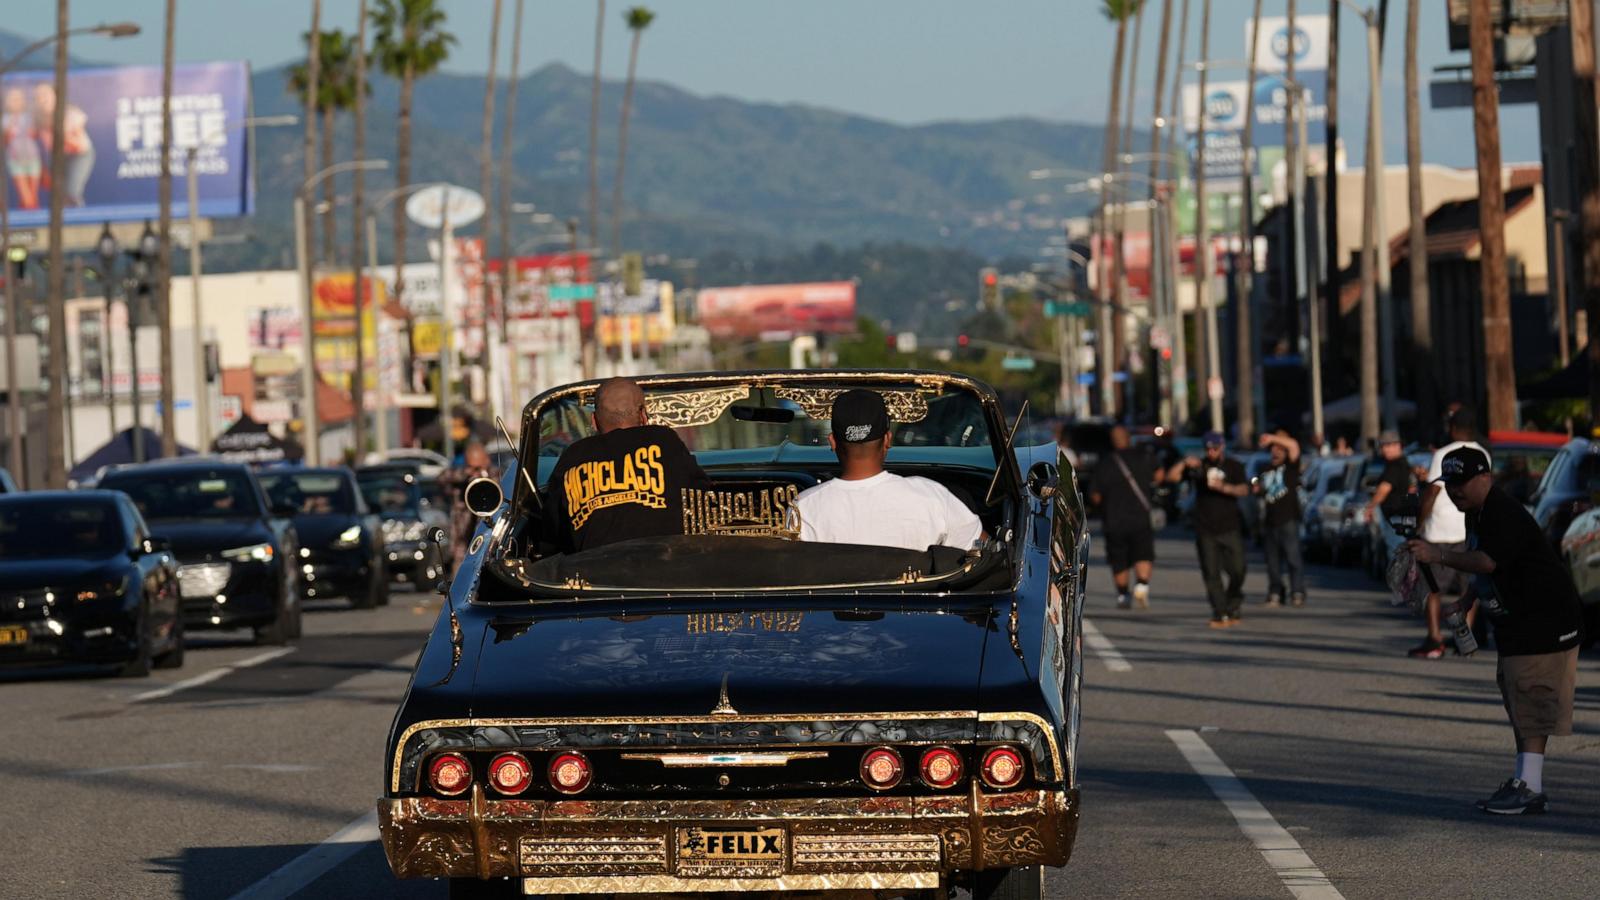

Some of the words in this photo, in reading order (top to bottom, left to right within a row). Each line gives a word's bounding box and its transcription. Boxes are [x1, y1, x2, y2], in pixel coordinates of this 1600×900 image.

[116, 110, 227, 151] FREE
[563, 444, 665, 517] HIGHCLASS
[588, 498, 603, 511] LOS
[603, 492, 637, 505] ANGELES
[681, 484, 801, 536] HIGHCLASS
[715, 529, 735, 537] LOS
[734, 528, 771, 537] ANGELES
[706, 835, 780, 854] FELIX
